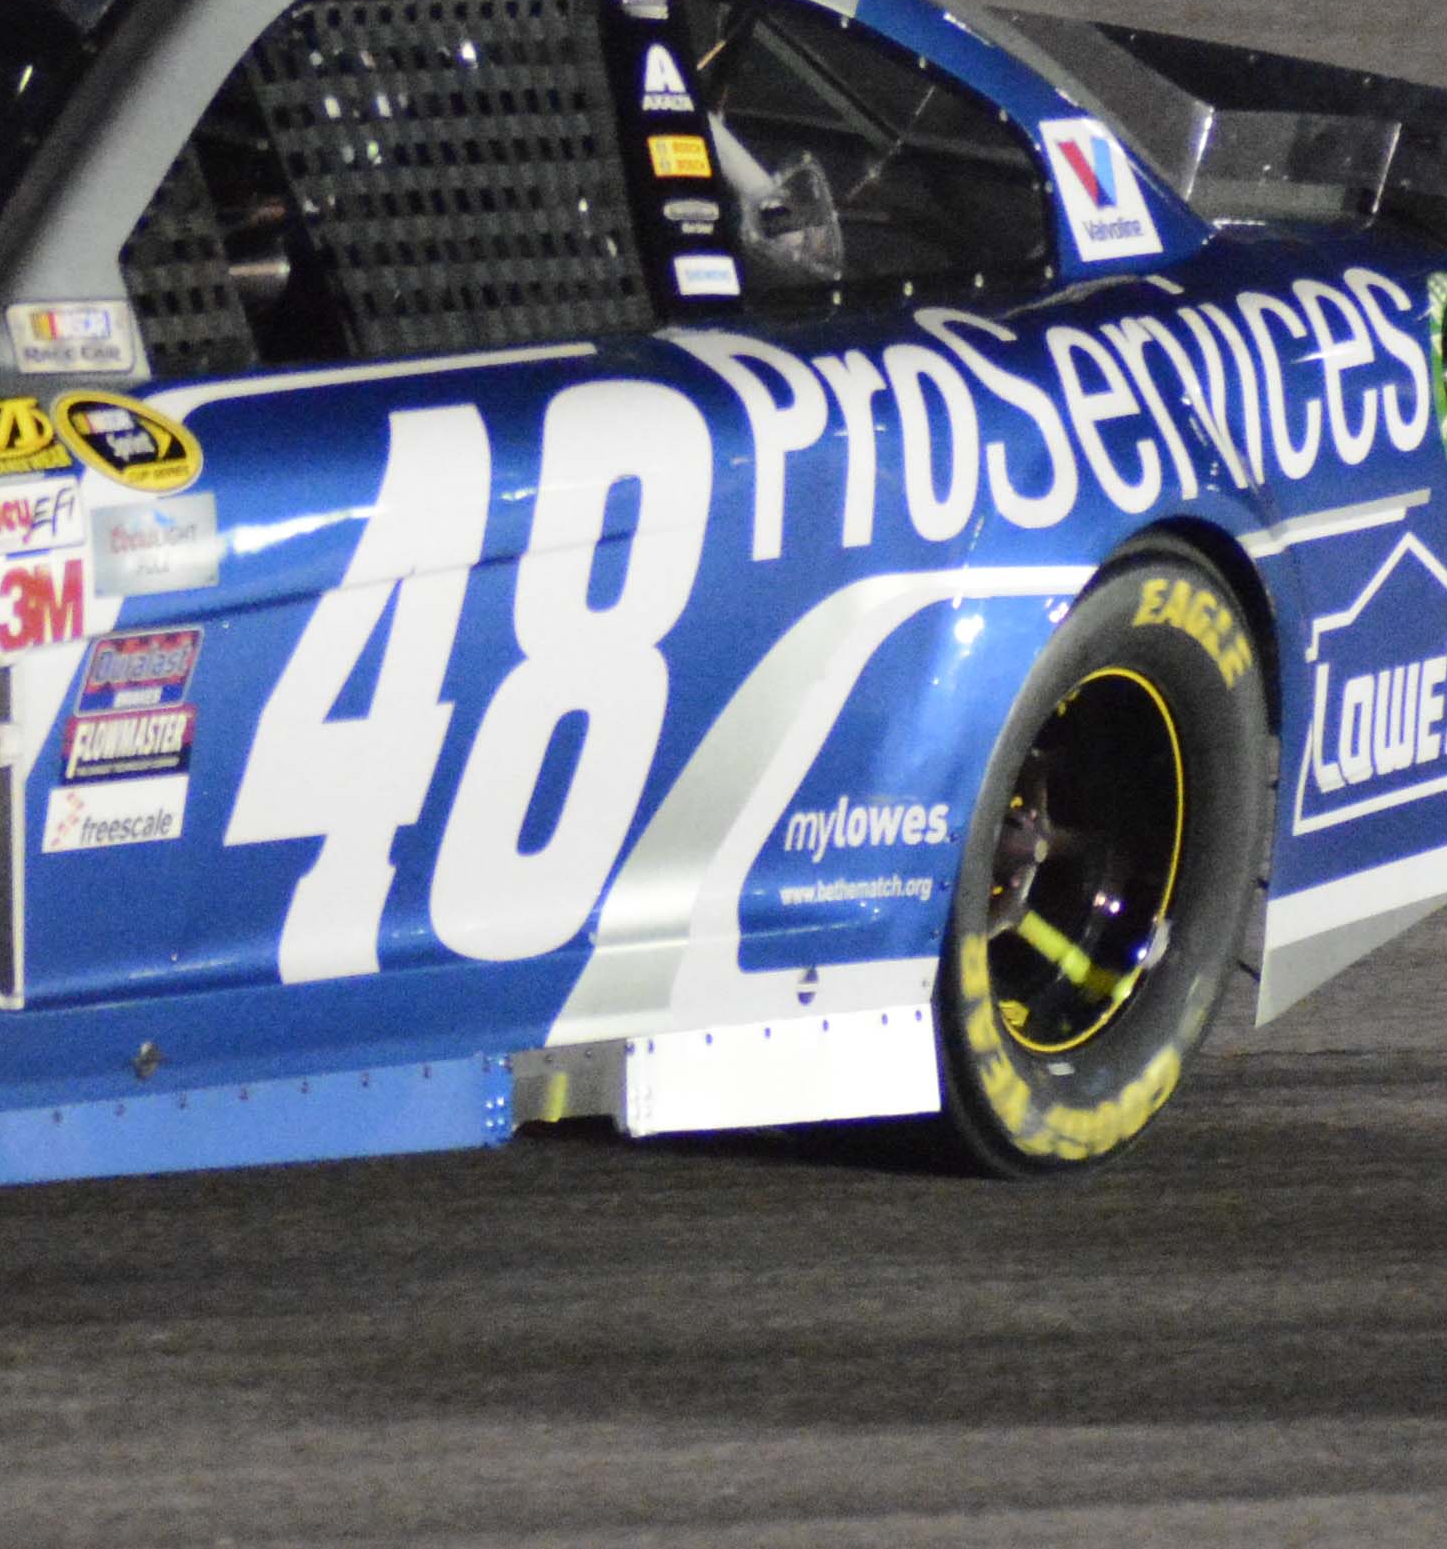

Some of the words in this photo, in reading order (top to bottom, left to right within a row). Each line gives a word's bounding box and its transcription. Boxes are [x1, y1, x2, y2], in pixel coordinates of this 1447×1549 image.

[653, 265, 1431, 564] ProServices
[1131, 578, 1255, 691] EAGLE
[221, 377, 715, 985] 48
[65, 712, 189, 781] FLOWMASTER
[79, 807, 175, 847] freescale
[783, 795, 952, 864] mylowes
[778, 873, 935, 907] www.bethematch.org
